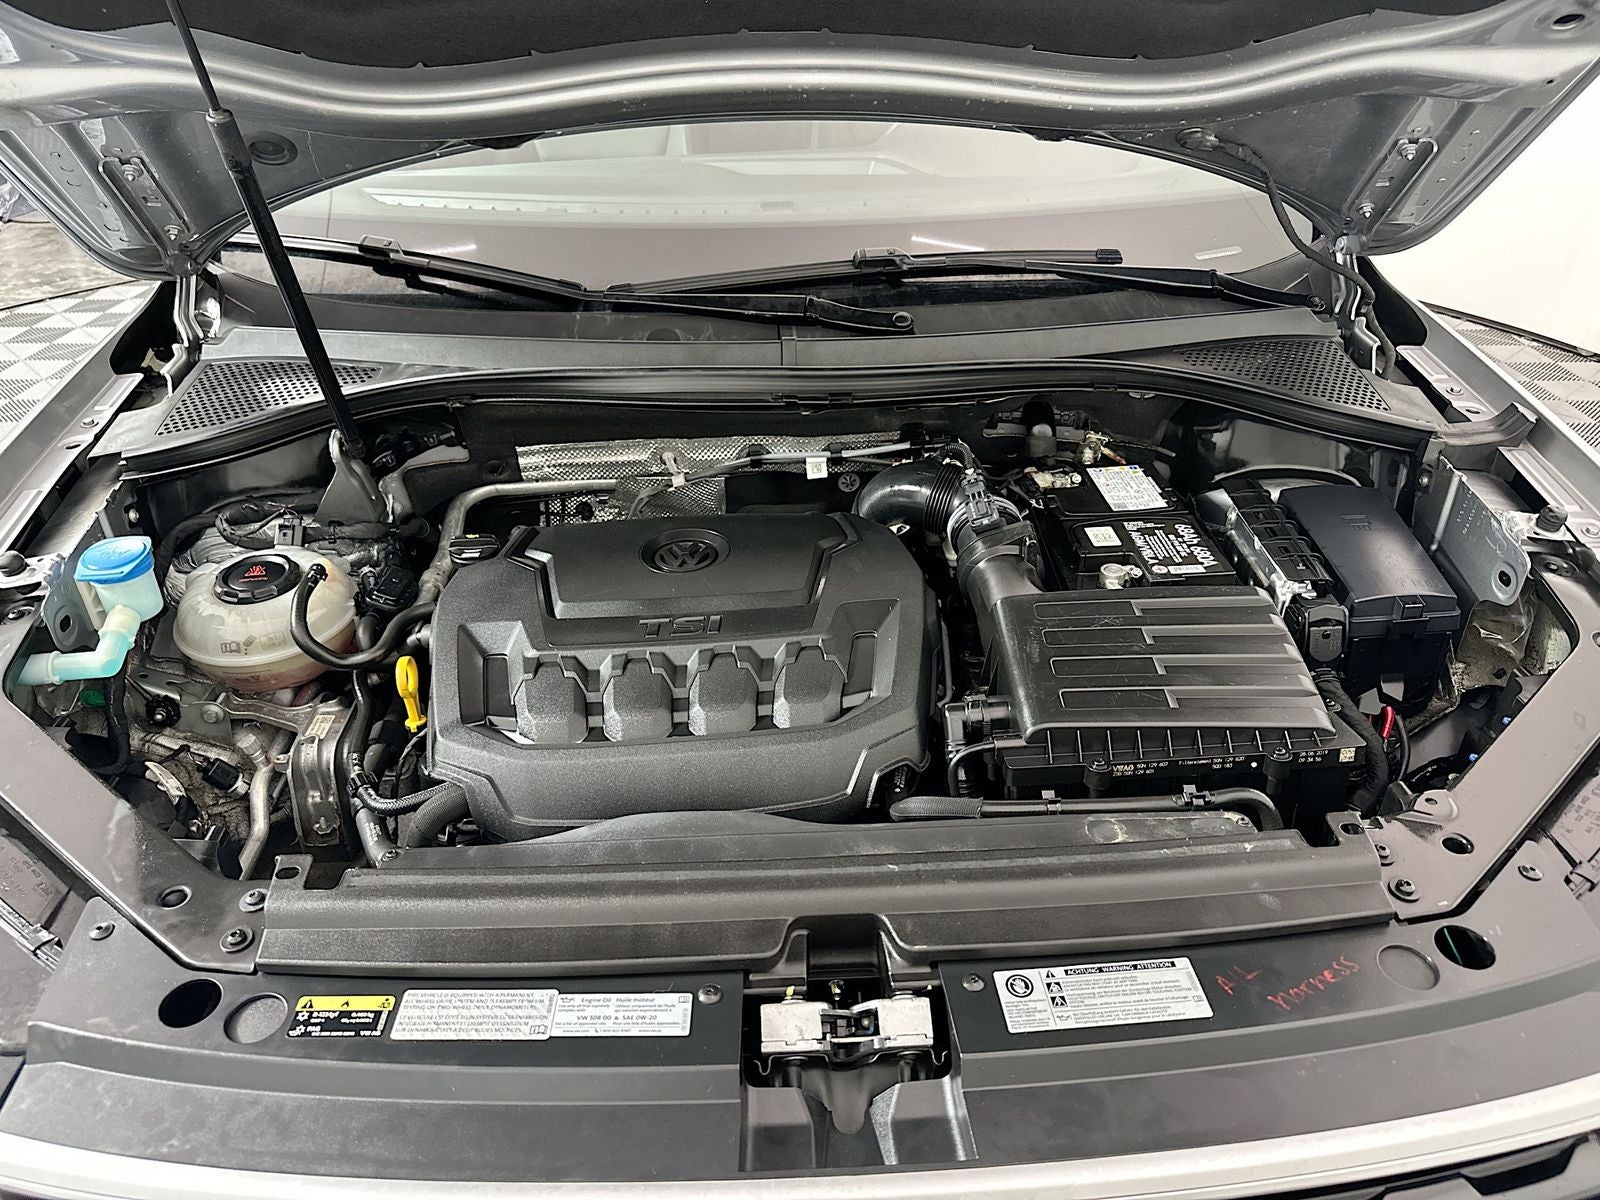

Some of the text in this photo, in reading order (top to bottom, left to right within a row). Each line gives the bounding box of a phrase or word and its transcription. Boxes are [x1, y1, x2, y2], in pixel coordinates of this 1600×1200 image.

[1174, 524, 1201, 545] 68Ah
[1190, 546, 1219, 567] 680A
[639, 615, 723, 638] TSI
[1067, 961, 1172, 975] ACHTUNG WARNING ATTENTION
